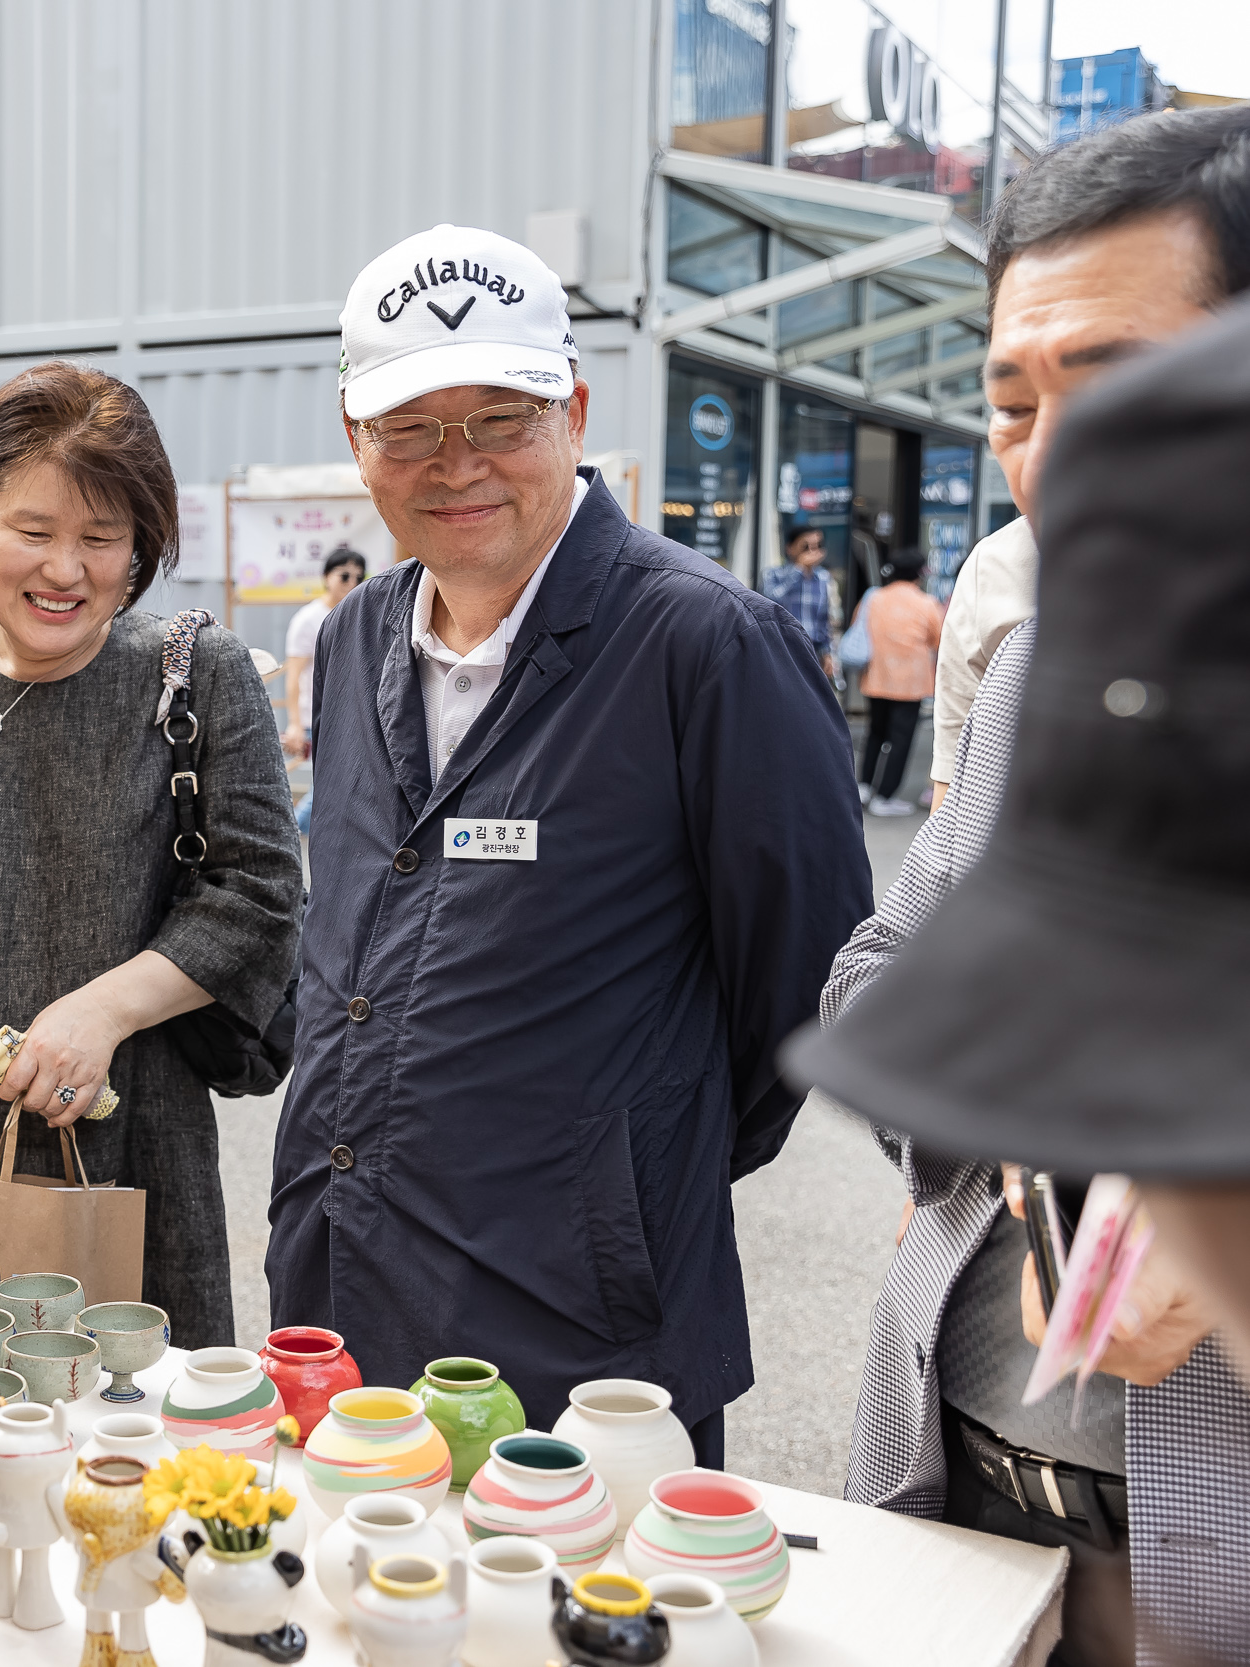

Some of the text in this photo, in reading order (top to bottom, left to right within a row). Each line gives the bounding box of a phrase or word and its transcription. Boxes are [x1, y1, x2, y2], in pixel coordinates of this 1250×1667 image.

[377, 257, 525, 322] Callaway
[504, 370, 564, 381] CHROME
[526, 376, 561, 386] SOFT
[482, 844, 520, 853] 광진구청장
